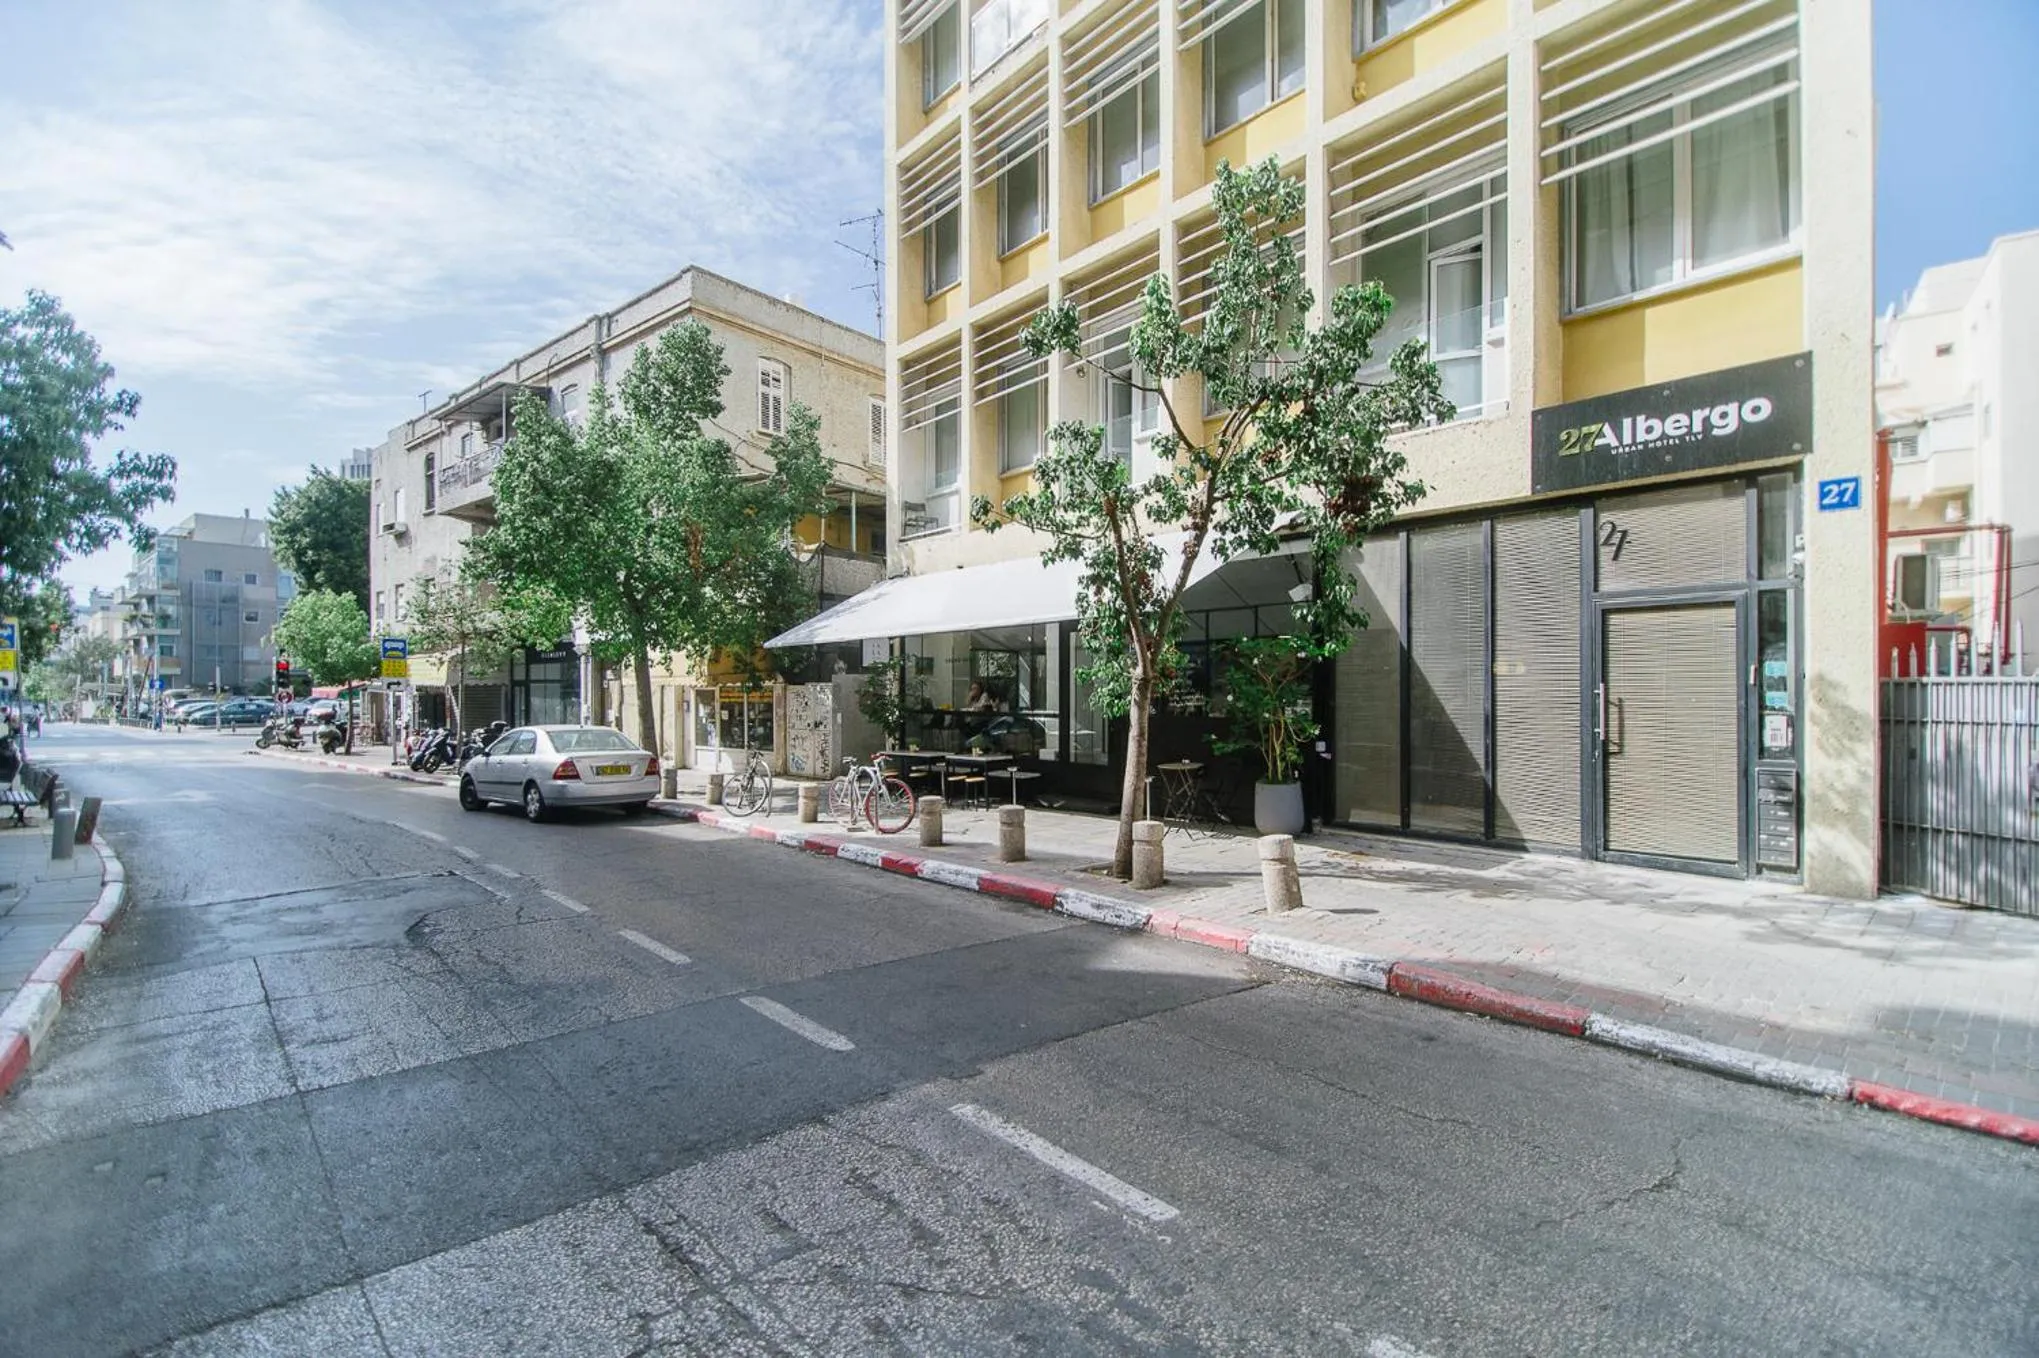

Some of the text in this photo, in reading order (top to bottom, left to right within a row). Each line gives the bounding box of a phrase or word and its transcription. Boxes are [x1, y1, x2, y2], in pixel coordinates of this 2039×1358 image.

[1558, 397, 1773, 457] 27 Albergo
[1610, 433, 1703, 455] URBAN HOTEL TLV
[1821, 481, 1856, 505] 27
[1600, 520, 1631, 561] 27
